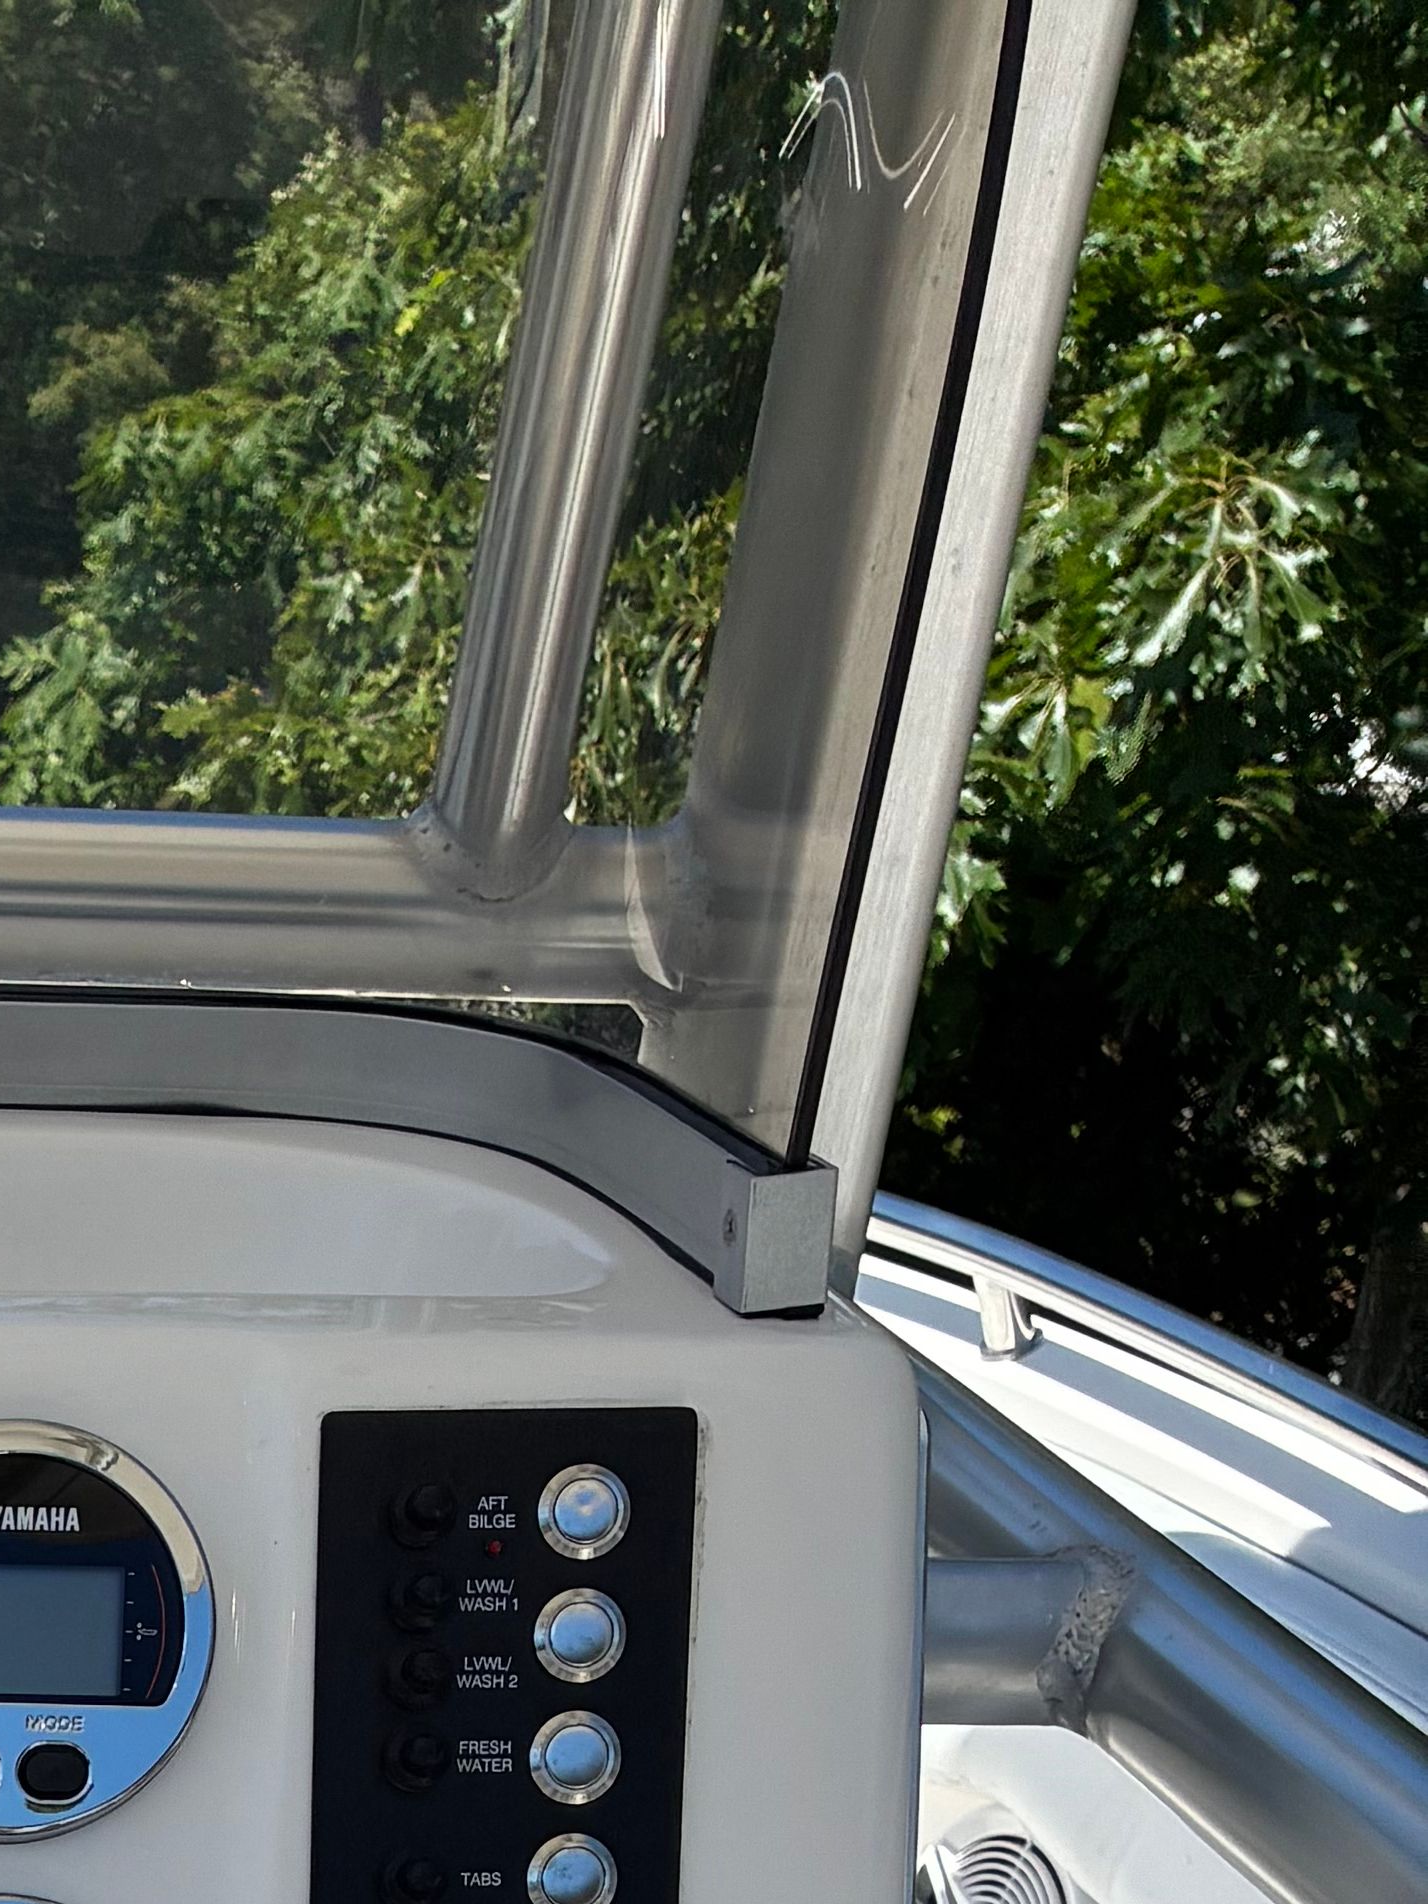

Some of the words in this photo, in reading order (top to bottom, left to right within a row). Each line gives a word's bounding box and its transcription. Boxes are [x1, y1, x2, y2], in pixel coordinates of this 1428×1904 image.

[477, 1496, 509, 1511] AFT
[468, 1514, 517, 1529] BILGE
[466, 1579, 515, 1595] LVWL/
[458, 1597, 509, 1612] WASH
[511, 1597, 519, 1611] 1
[463, 1656, 513, 1672] LVWL/
[456, 1674, 506, 1689] WASH
[508, 1674, 518, 1689] 2
[25, 1715, 85, 1732] MODE
[458, 1740, 512, 1755] FRESH
[456, 1757, 513, 1773] WATER
[460, 1872, 502, 1887] TABS
